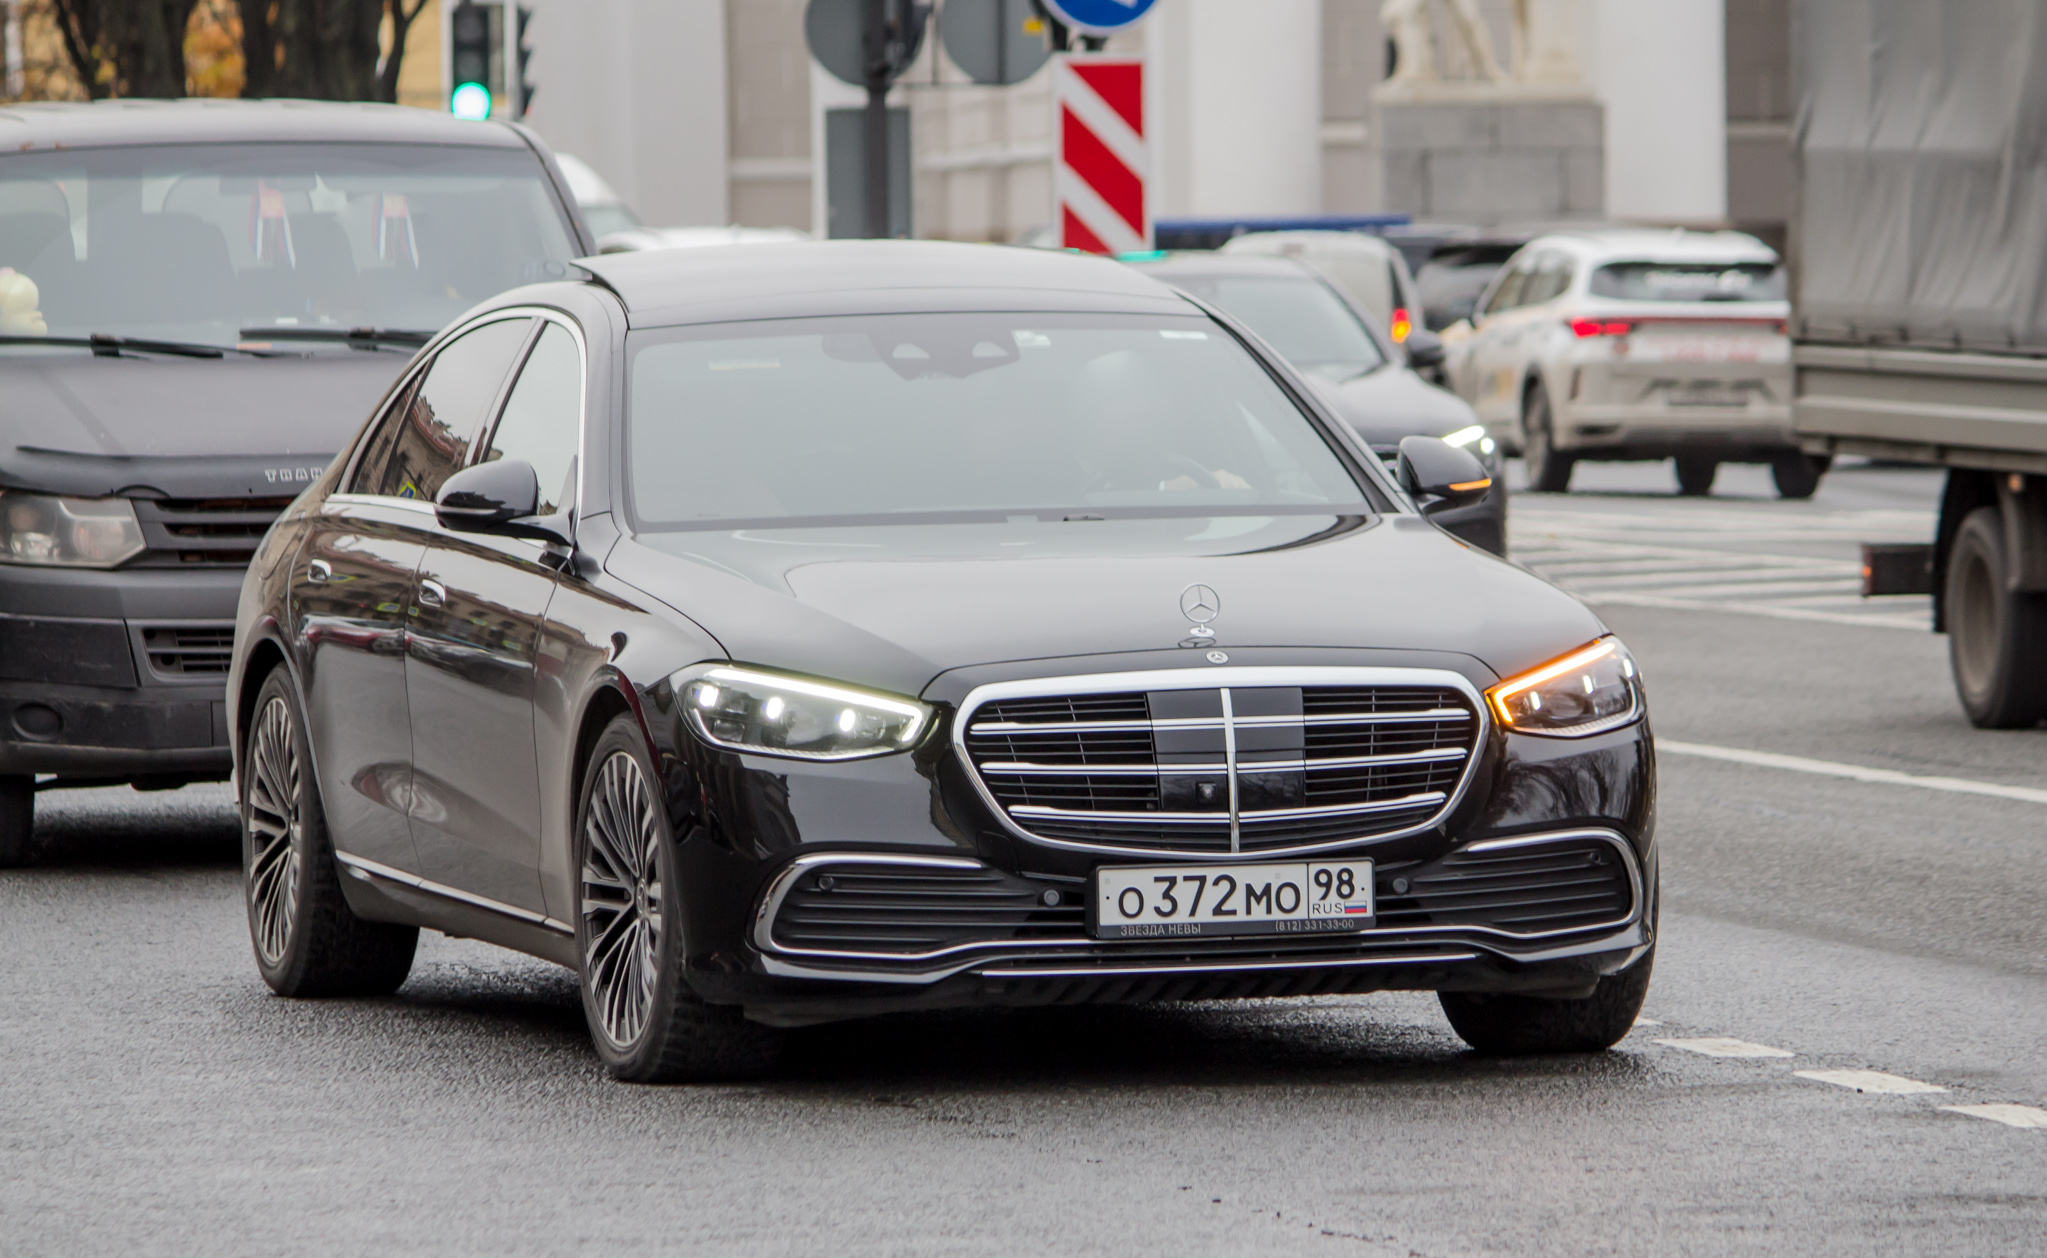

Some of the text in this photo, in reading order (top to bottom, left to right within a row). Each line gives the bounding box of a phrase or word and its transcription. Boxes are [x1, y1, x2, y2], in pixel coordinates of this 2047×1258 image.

[1313, 867, 1355, 901] 98
[1312, 902, 1343, 914] RUS
[1120, 923, 1201, 937] ЗВЕЗДА НЕВЫ
[1275, 918, 1355, 932] (812) 331-33-00
